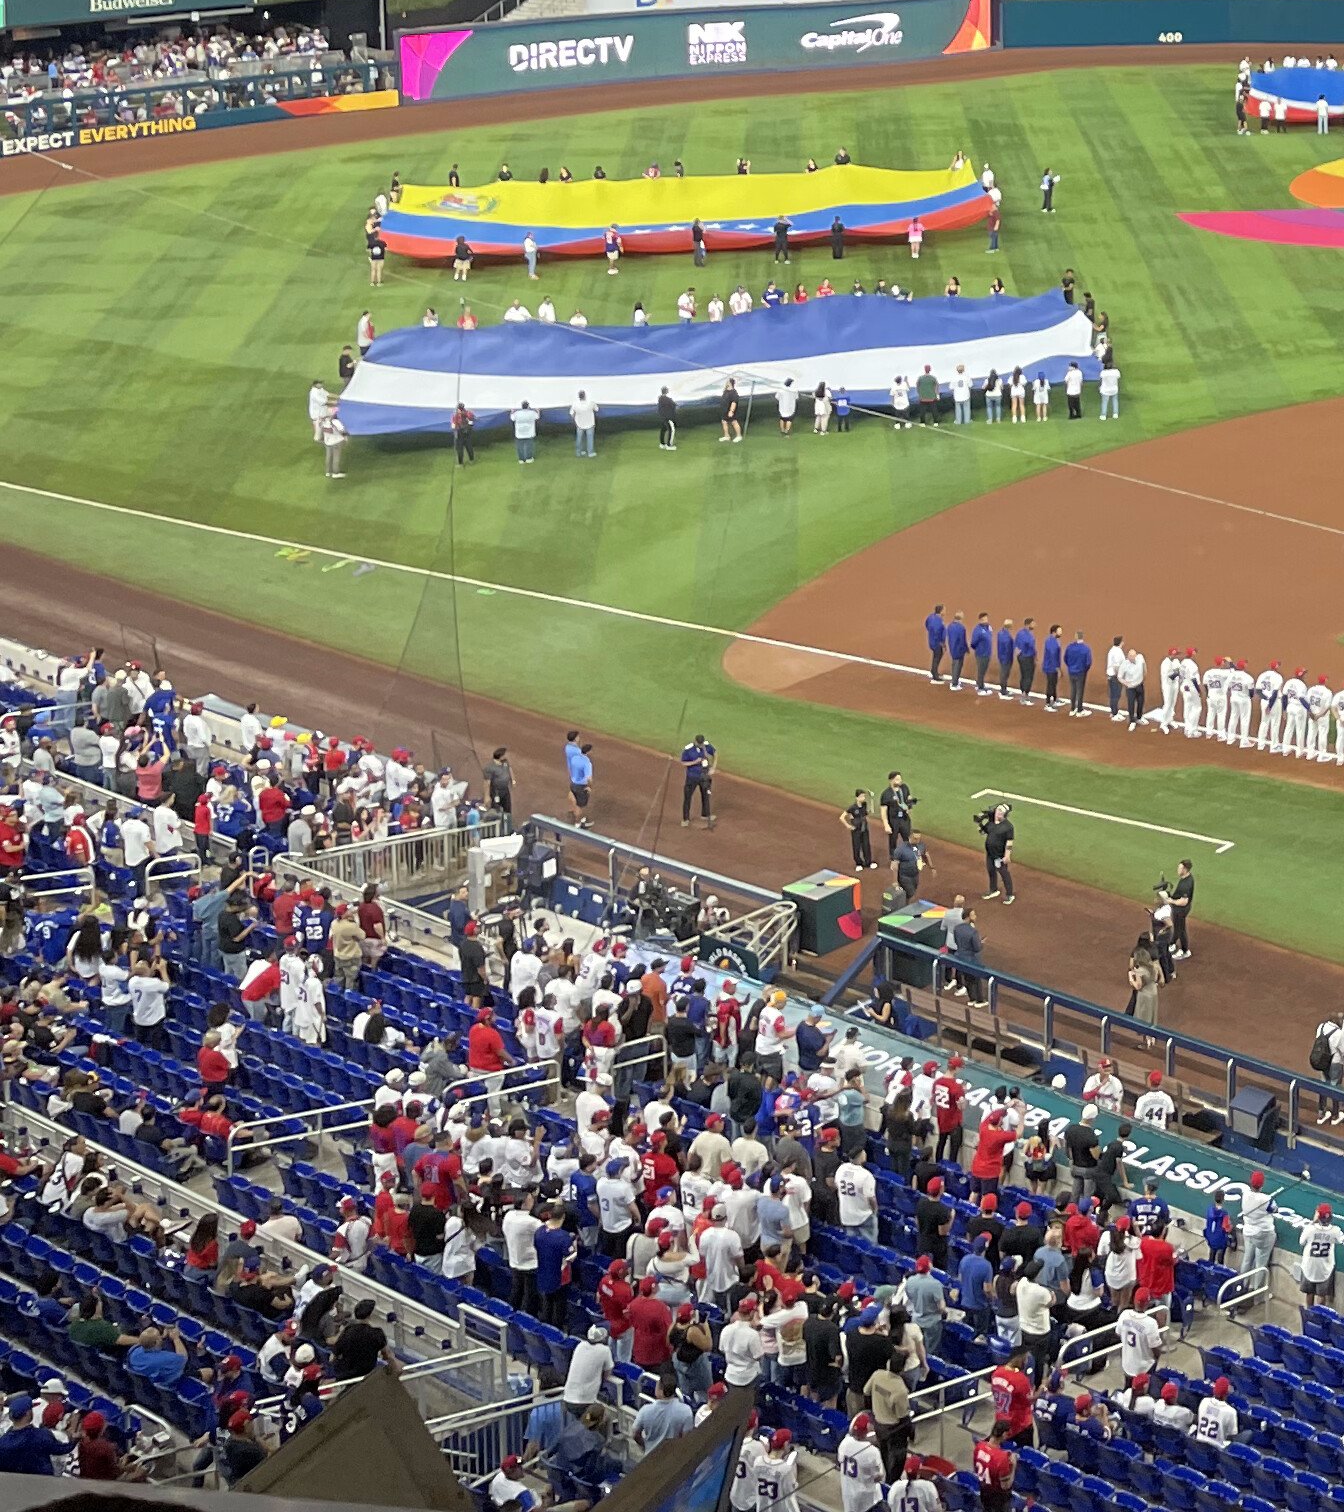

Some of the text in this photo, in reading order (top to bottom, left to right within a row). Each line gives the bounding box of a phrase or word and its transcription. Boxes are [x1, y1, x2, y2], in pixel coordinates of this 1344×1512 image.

[1158, 32, 1183, 43] 400
[509, 34, 634, 72] DIRECTV
[689, 42, 746, 56] NIPPON
[689, 53, 746, 66] EXPRESS
[2, 116, 197, 156] EXPECT EVERYTHING
[1145, 1106, 1163, 1121] 44
[840, 1179, 856, 1197] 22
[601, 1199, 609, 1212] 3
[682, 1192, 695, 1208] 13
[1309, 1241, 1331, 1258] 22
[1199, 1416, 1219, 1438] 22
[843, 1454, 859, 1478] 13
[757, 1478, 778, 1500] 23
